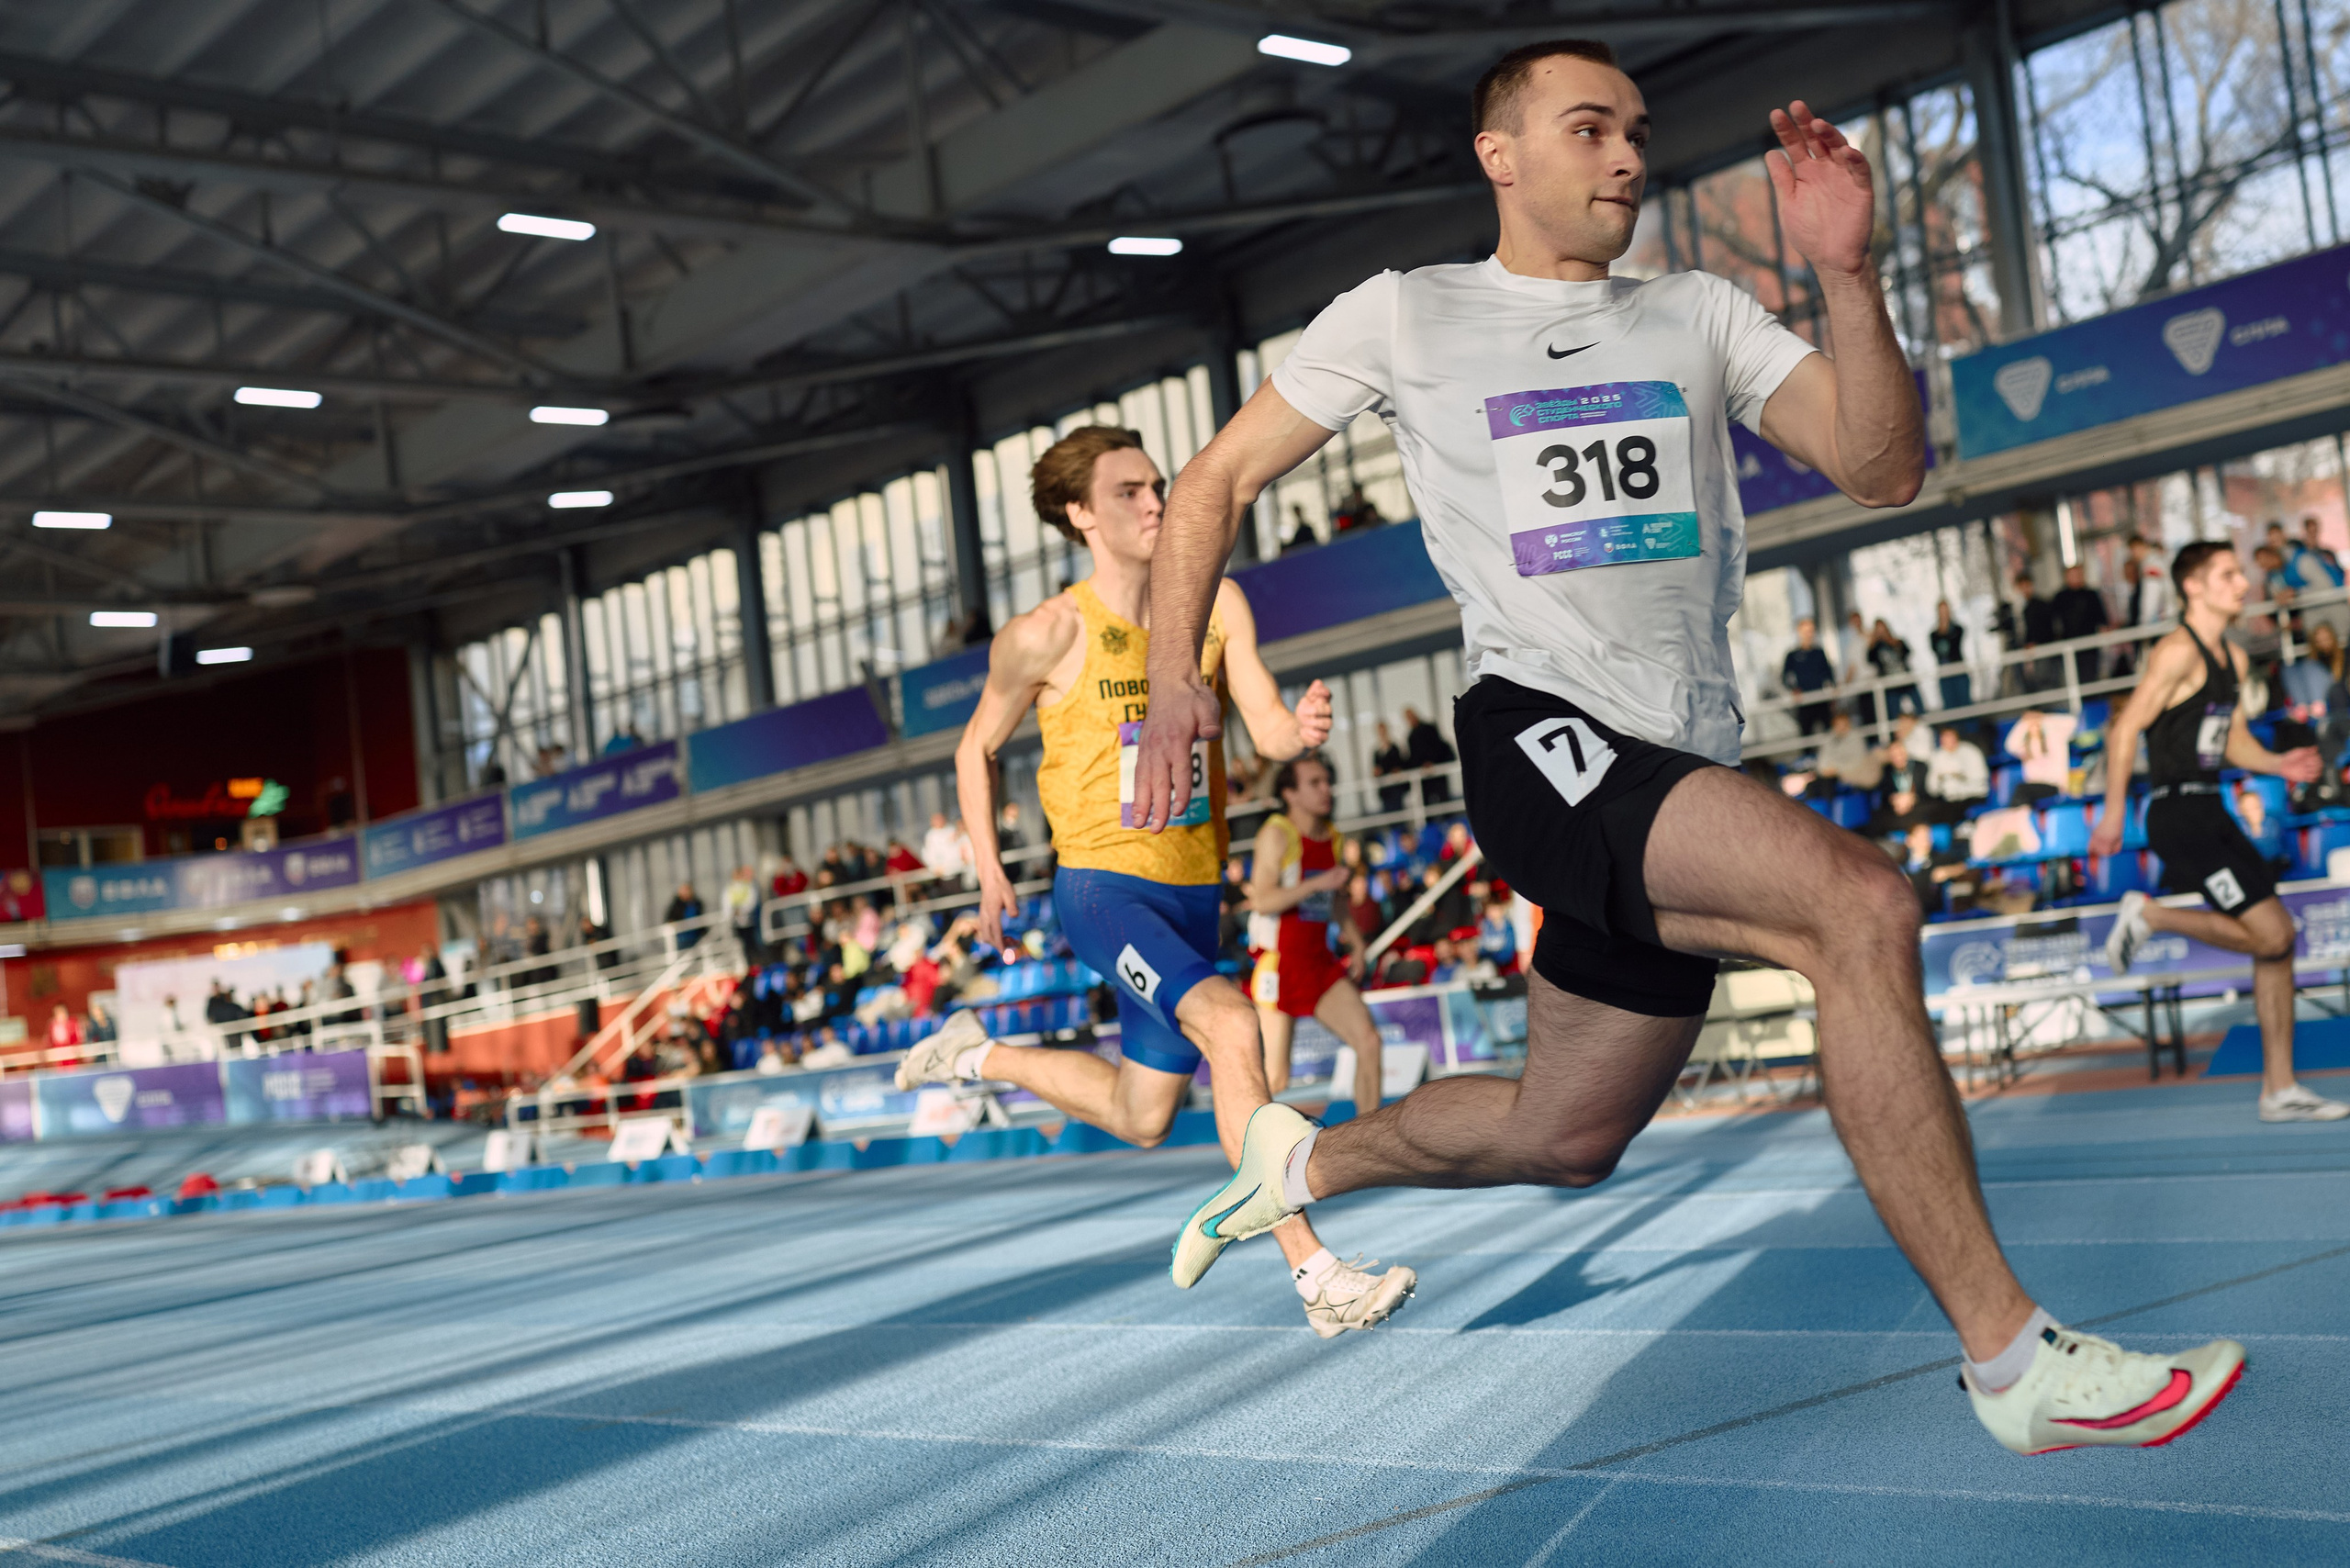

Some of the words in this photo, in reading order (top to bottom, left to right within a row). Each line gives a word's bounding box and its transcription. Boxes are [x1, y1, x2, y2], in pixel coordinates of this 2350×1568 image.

[1581, 393, 1621, 405] 2025
[1538, 412, 1579, 424] СПОРТА
[1536, 435, 1660, 509] 318
[1537, 724, 1587, 778] 7
[2215, 879, 2235, 902] 2
[1125, 962, 1147, 992] 6
